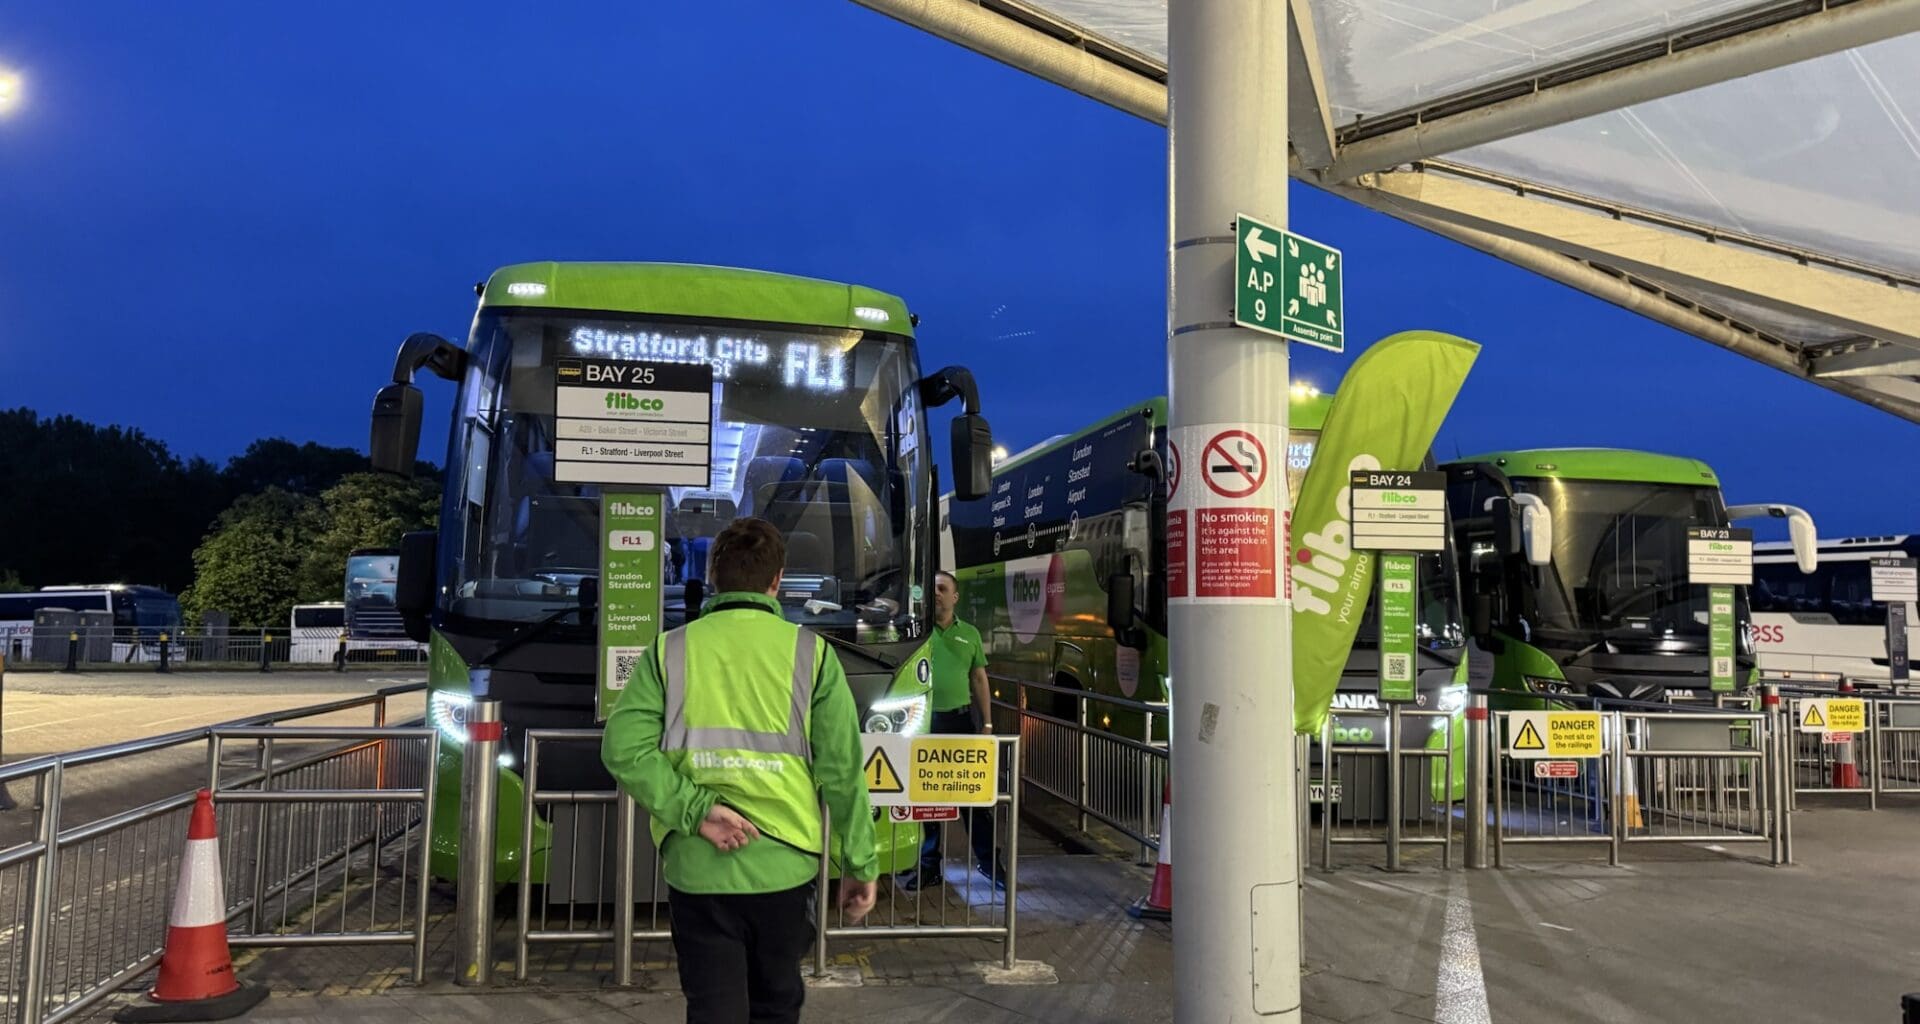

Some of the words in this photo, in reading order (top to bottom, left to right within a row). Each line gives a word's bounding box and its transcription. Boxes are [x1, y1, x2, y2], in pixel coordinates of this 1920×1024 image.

[1247, 267, 1274, 293] A.P
[1254, 299, 1266, 321] 9
[1293, 323, 1319, 340] Assembly
[1319, 332, 1333, 343] point
[574, 329, 706, 356] Stratford
[716, 337, 768, 364] City
[784, 343, 846, 388] FL1
[586, 365, 627, 382] BAY
[631, 367, 655, 384] 25
[605, 392, 664, 411] flibco
[617, 427, 638, 436] Street
[668, 429, 688, 437] Street
[582, 446, 593, 455] FL1
[600, 447, 628, 456] Stratford
[634, 448, 664, 458] Liverpool
[664, 449, 684, 458] Street
[1072, 444, 1092, 462] London
[1068, 462, 1091, 483] Stansted
[1370, 475, 1394, 486] BAY
[1397, 475, 1412, 486] 24
[1028, 484, 1044, 499] London
[1067, 487, 1086, 505] Airport
[1382, 492, 1417, 503] flibco
[610, 502, 655, 516] flibco
[1024, 501, 1043, 519] Stratford
[1201, 513, 1218, 523] No
[1220, 512, 1269, 525] smoking
[1209, 527, 1216, 535] is
[1218, 527, 1250, 536] against
[1252, 527, 1266, 535] the
[1700, 530, 1718, 539] BAY
[1718, 530, 1730, 539] 23
[622, 536, 642, 545] FL1
[1201, 537, 1217, 545] law
[1384, 561, 1411, 570] flibco
[608, 572, 643, 580] London
[608, 581, 651, 589] Stratford
[1013, 571, 1040, 602] flibco
[1337, 592, 1356, 625] your
[608, 614, 651, 623] Liverpool
[608, 623, 636, 631] Street
[1829, 704, 1860, 712] DANGER
[1551, 720, 1595, 730] DANGER
[1568, 742, 1592, 750] railings
[693, 751, 784, 773] flibco.com
[917, 749, 988, 764] DANGER
[918, 768, 934, 779] Do
[936, 768, 954, 779] not
[956, 768, 970, 779] sit
[972, 770, 986, 779] on
[922, 781, 939, 791] the
[942, 781, 982, 794] railings
